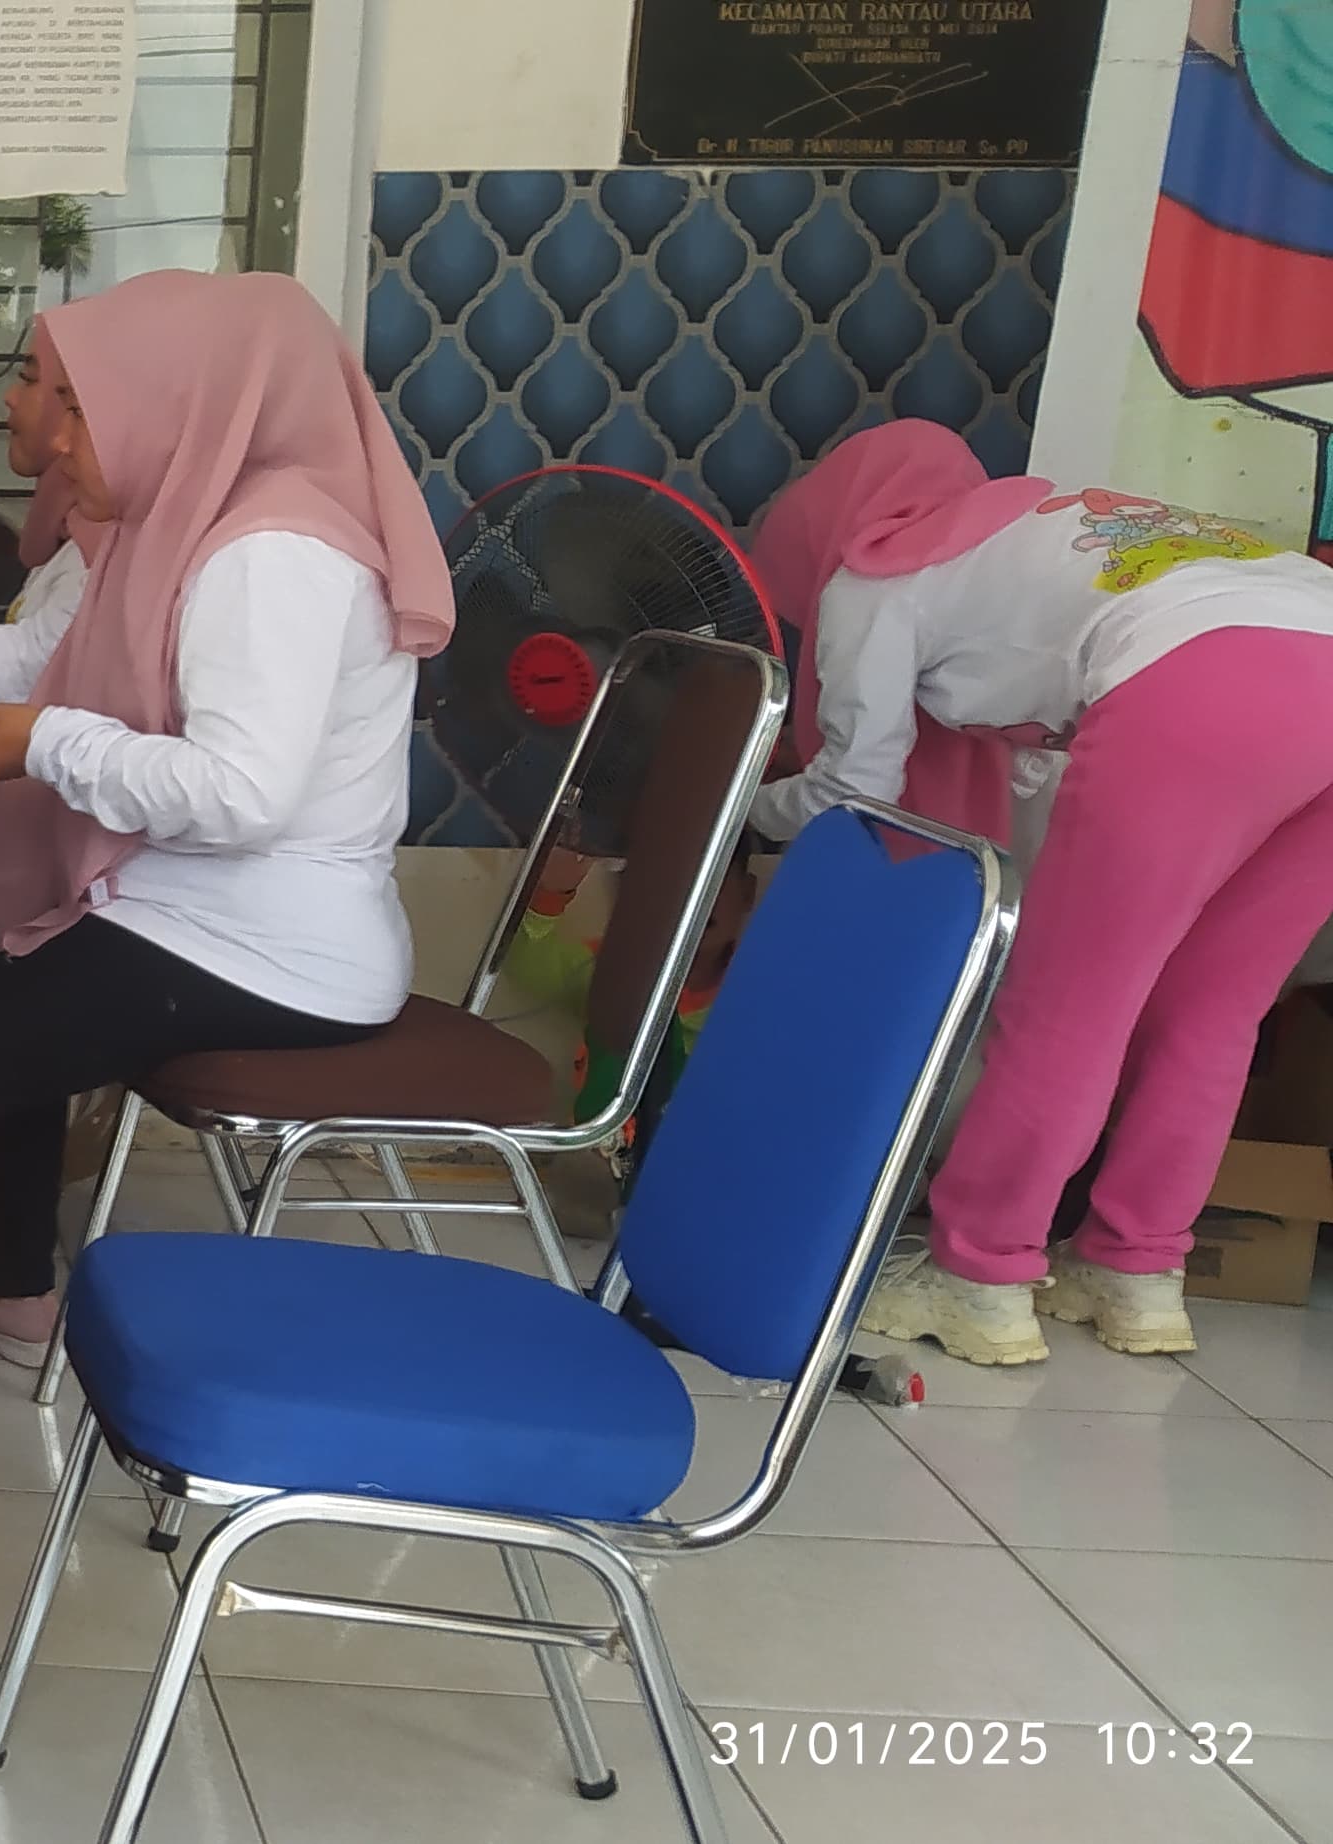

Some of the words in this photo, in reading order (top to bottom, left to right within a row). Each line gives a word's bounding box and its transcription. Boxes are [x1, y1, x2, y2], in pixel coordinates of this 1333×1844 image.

[718, 3, 847, 21] KECAMATAN
[860, 3, 948, 21] RANTAU
[961, 2, 1032, 20] UTARA
